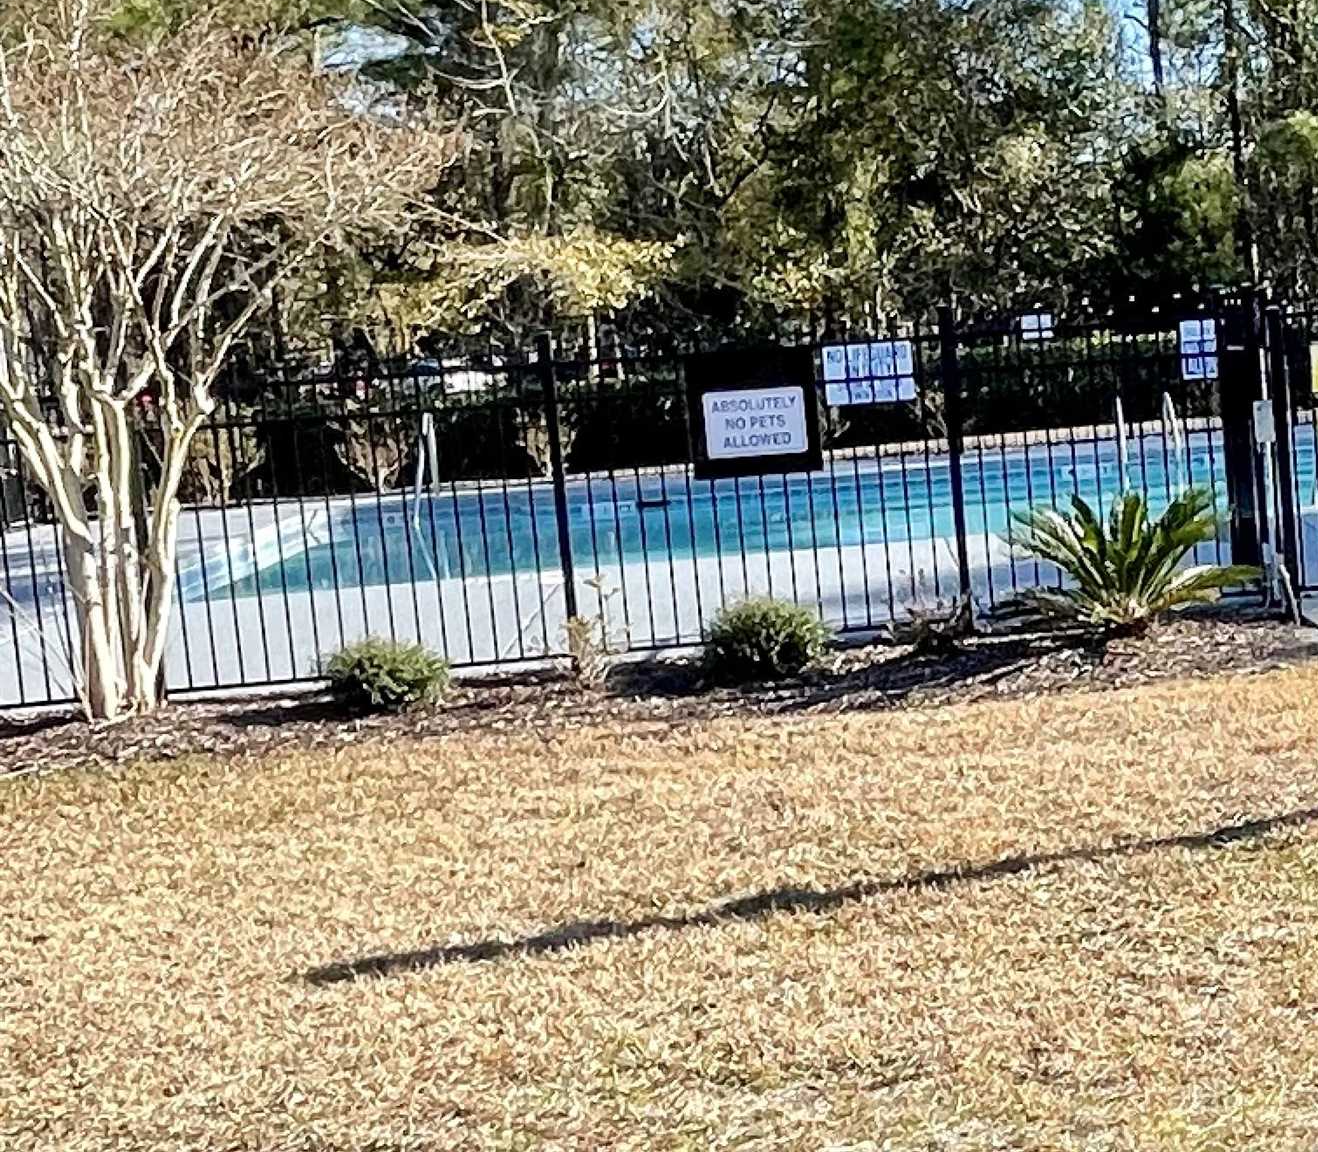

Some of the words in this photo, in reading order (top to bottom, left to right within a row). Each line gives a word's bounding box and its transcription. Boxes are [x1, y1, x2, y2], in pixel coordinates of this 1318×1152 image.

[711, 395, 797, 413] ABSOLUTELY
[725, 417, 746, 430] NO
[750, 414, 786, 428] PETS
[723, 432, 792, 448] ALLOWED
